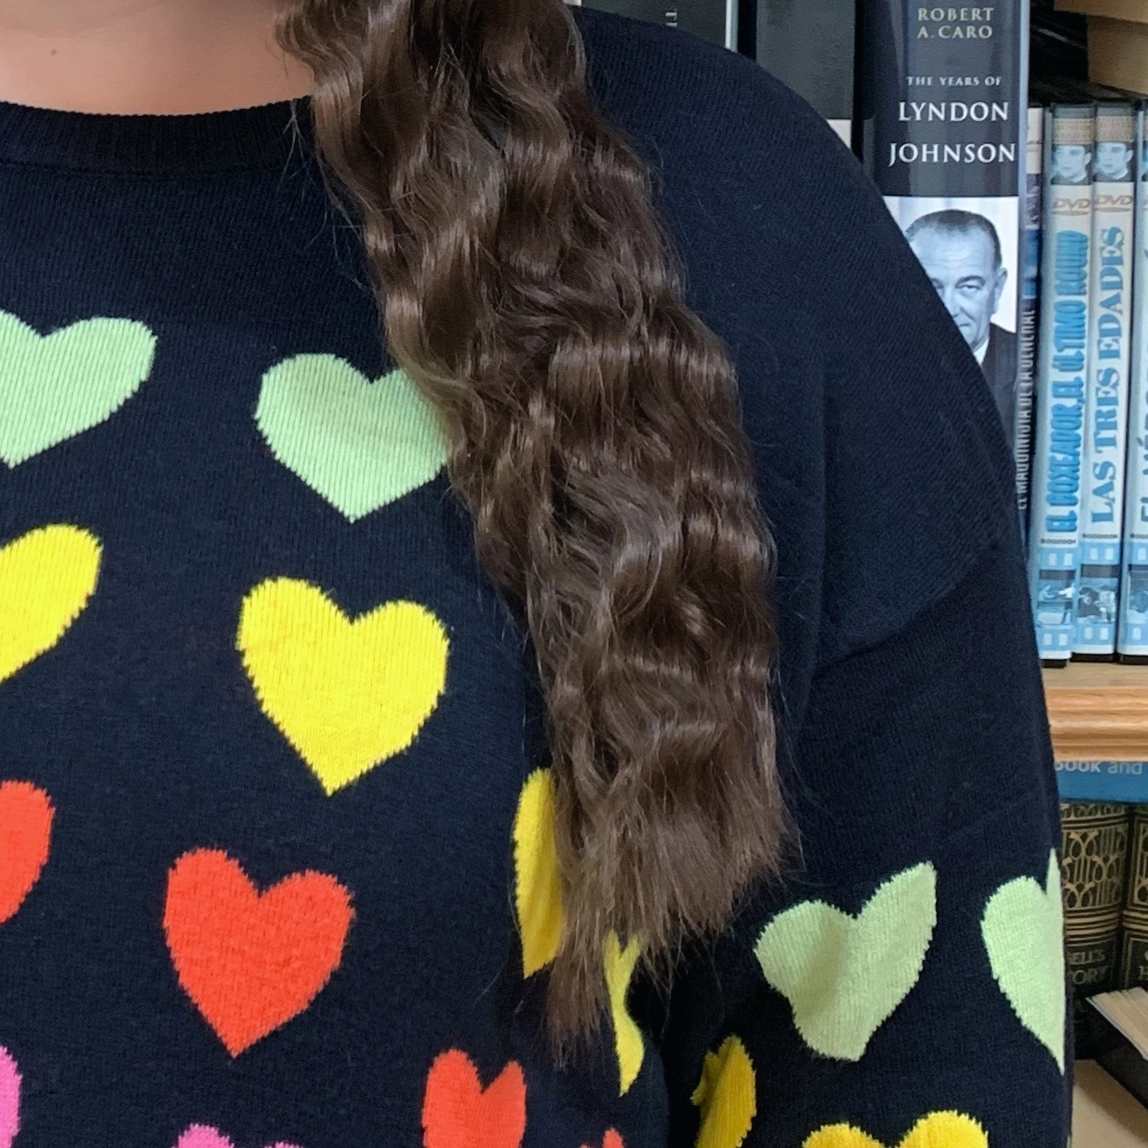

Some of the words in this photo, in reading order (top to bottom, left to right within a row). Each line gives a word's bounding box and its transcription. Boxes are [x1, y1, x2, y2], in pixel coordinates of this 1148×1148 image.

[917, 7, 995, 22] ROBERT
[917, 26, 935, 39] A.
[938, 25, 994, 39] CARO
[907, 76, 933, 86] THE
[940, 76, 980, 86] YEARS
[985, 76, 1002, 86] OF
[898, 102, 1009, 122] LYNDON
[888, 143, 1017, 167] JOHNSON
[1054, 197, 1090, 210] DVD
[1093, 194, 1132, 206] DVD
[1098, 225, 1126, 361] EDADES
[1093, 366, 1121, 452] TRES
[1091, 460, 1117, 524] LAS
[1045, 510, 1079, 533] EL
